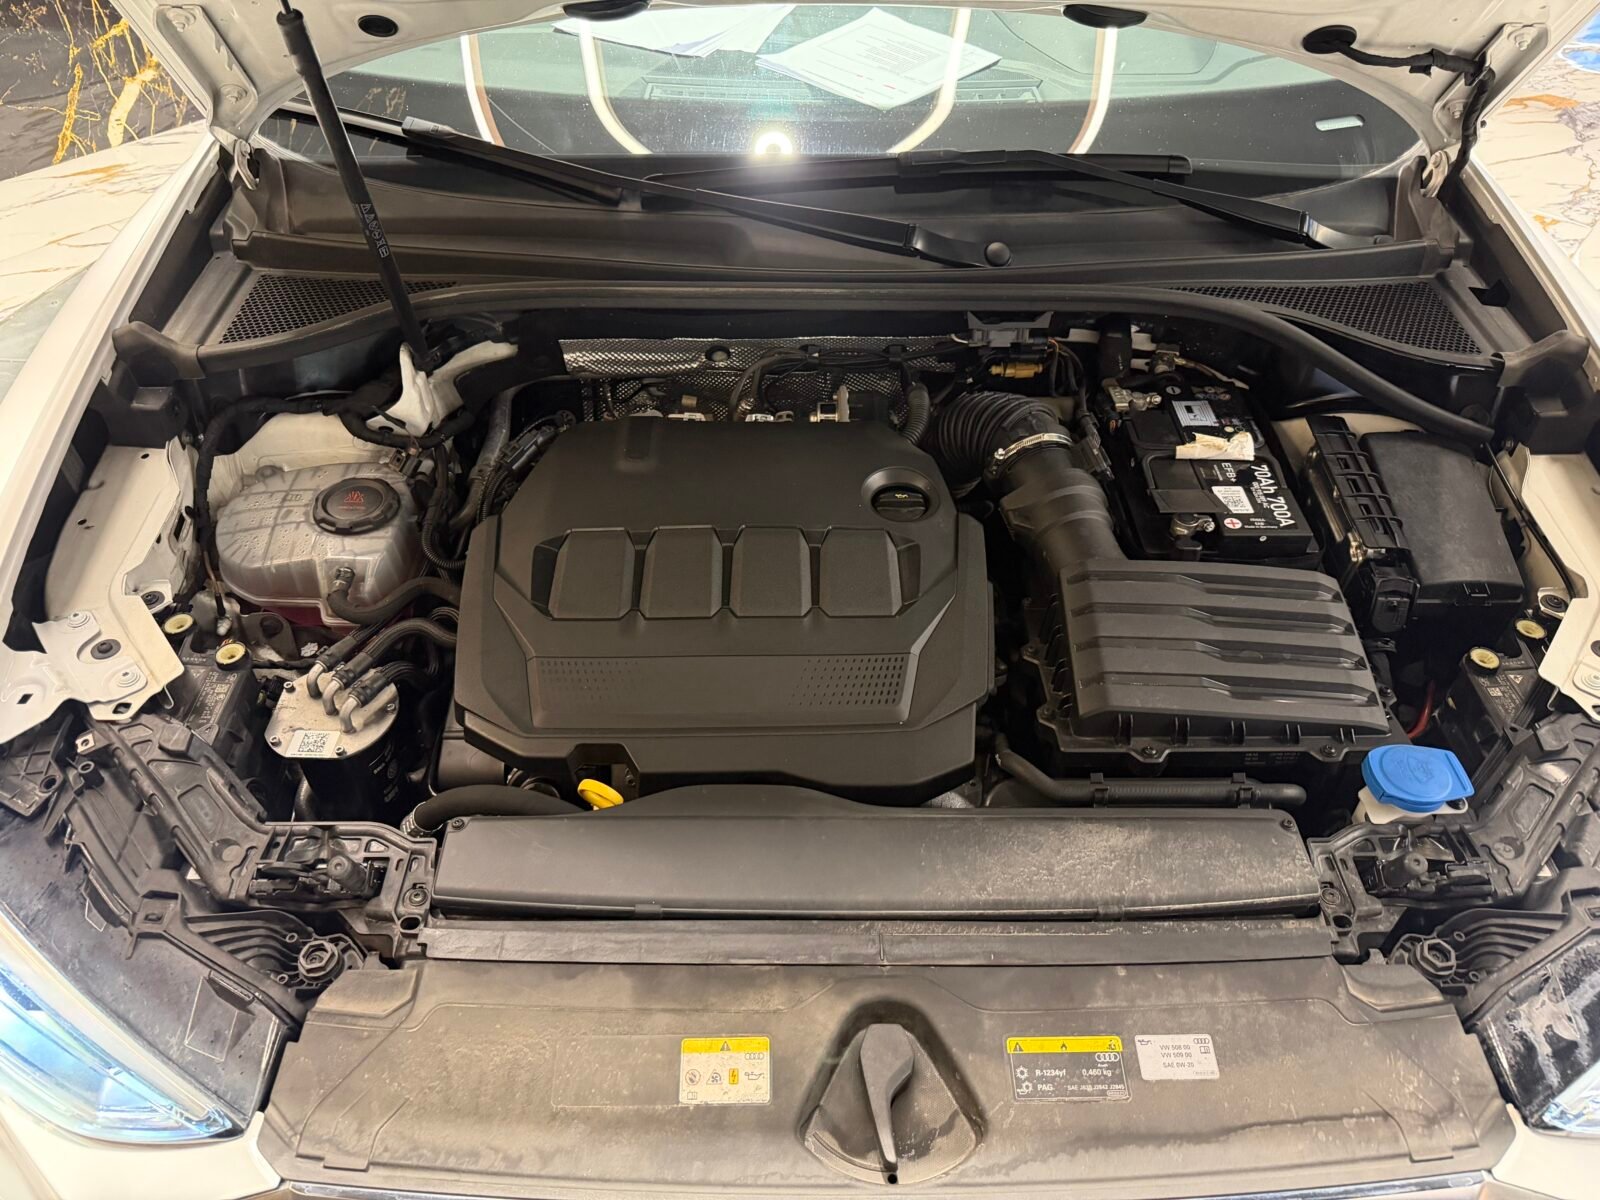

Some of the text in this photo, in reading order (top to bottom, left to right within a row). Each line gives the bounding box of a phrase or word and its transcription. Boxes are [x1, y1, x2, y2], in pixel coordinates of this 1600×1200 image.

[1221, 462, 1237, 482] EFB+
[1251, 464, 1278, 494] 70Ah
[1266, 496, 1296, 527] 700A
[1036, 1069, 1066, 1077] R-1234yf
